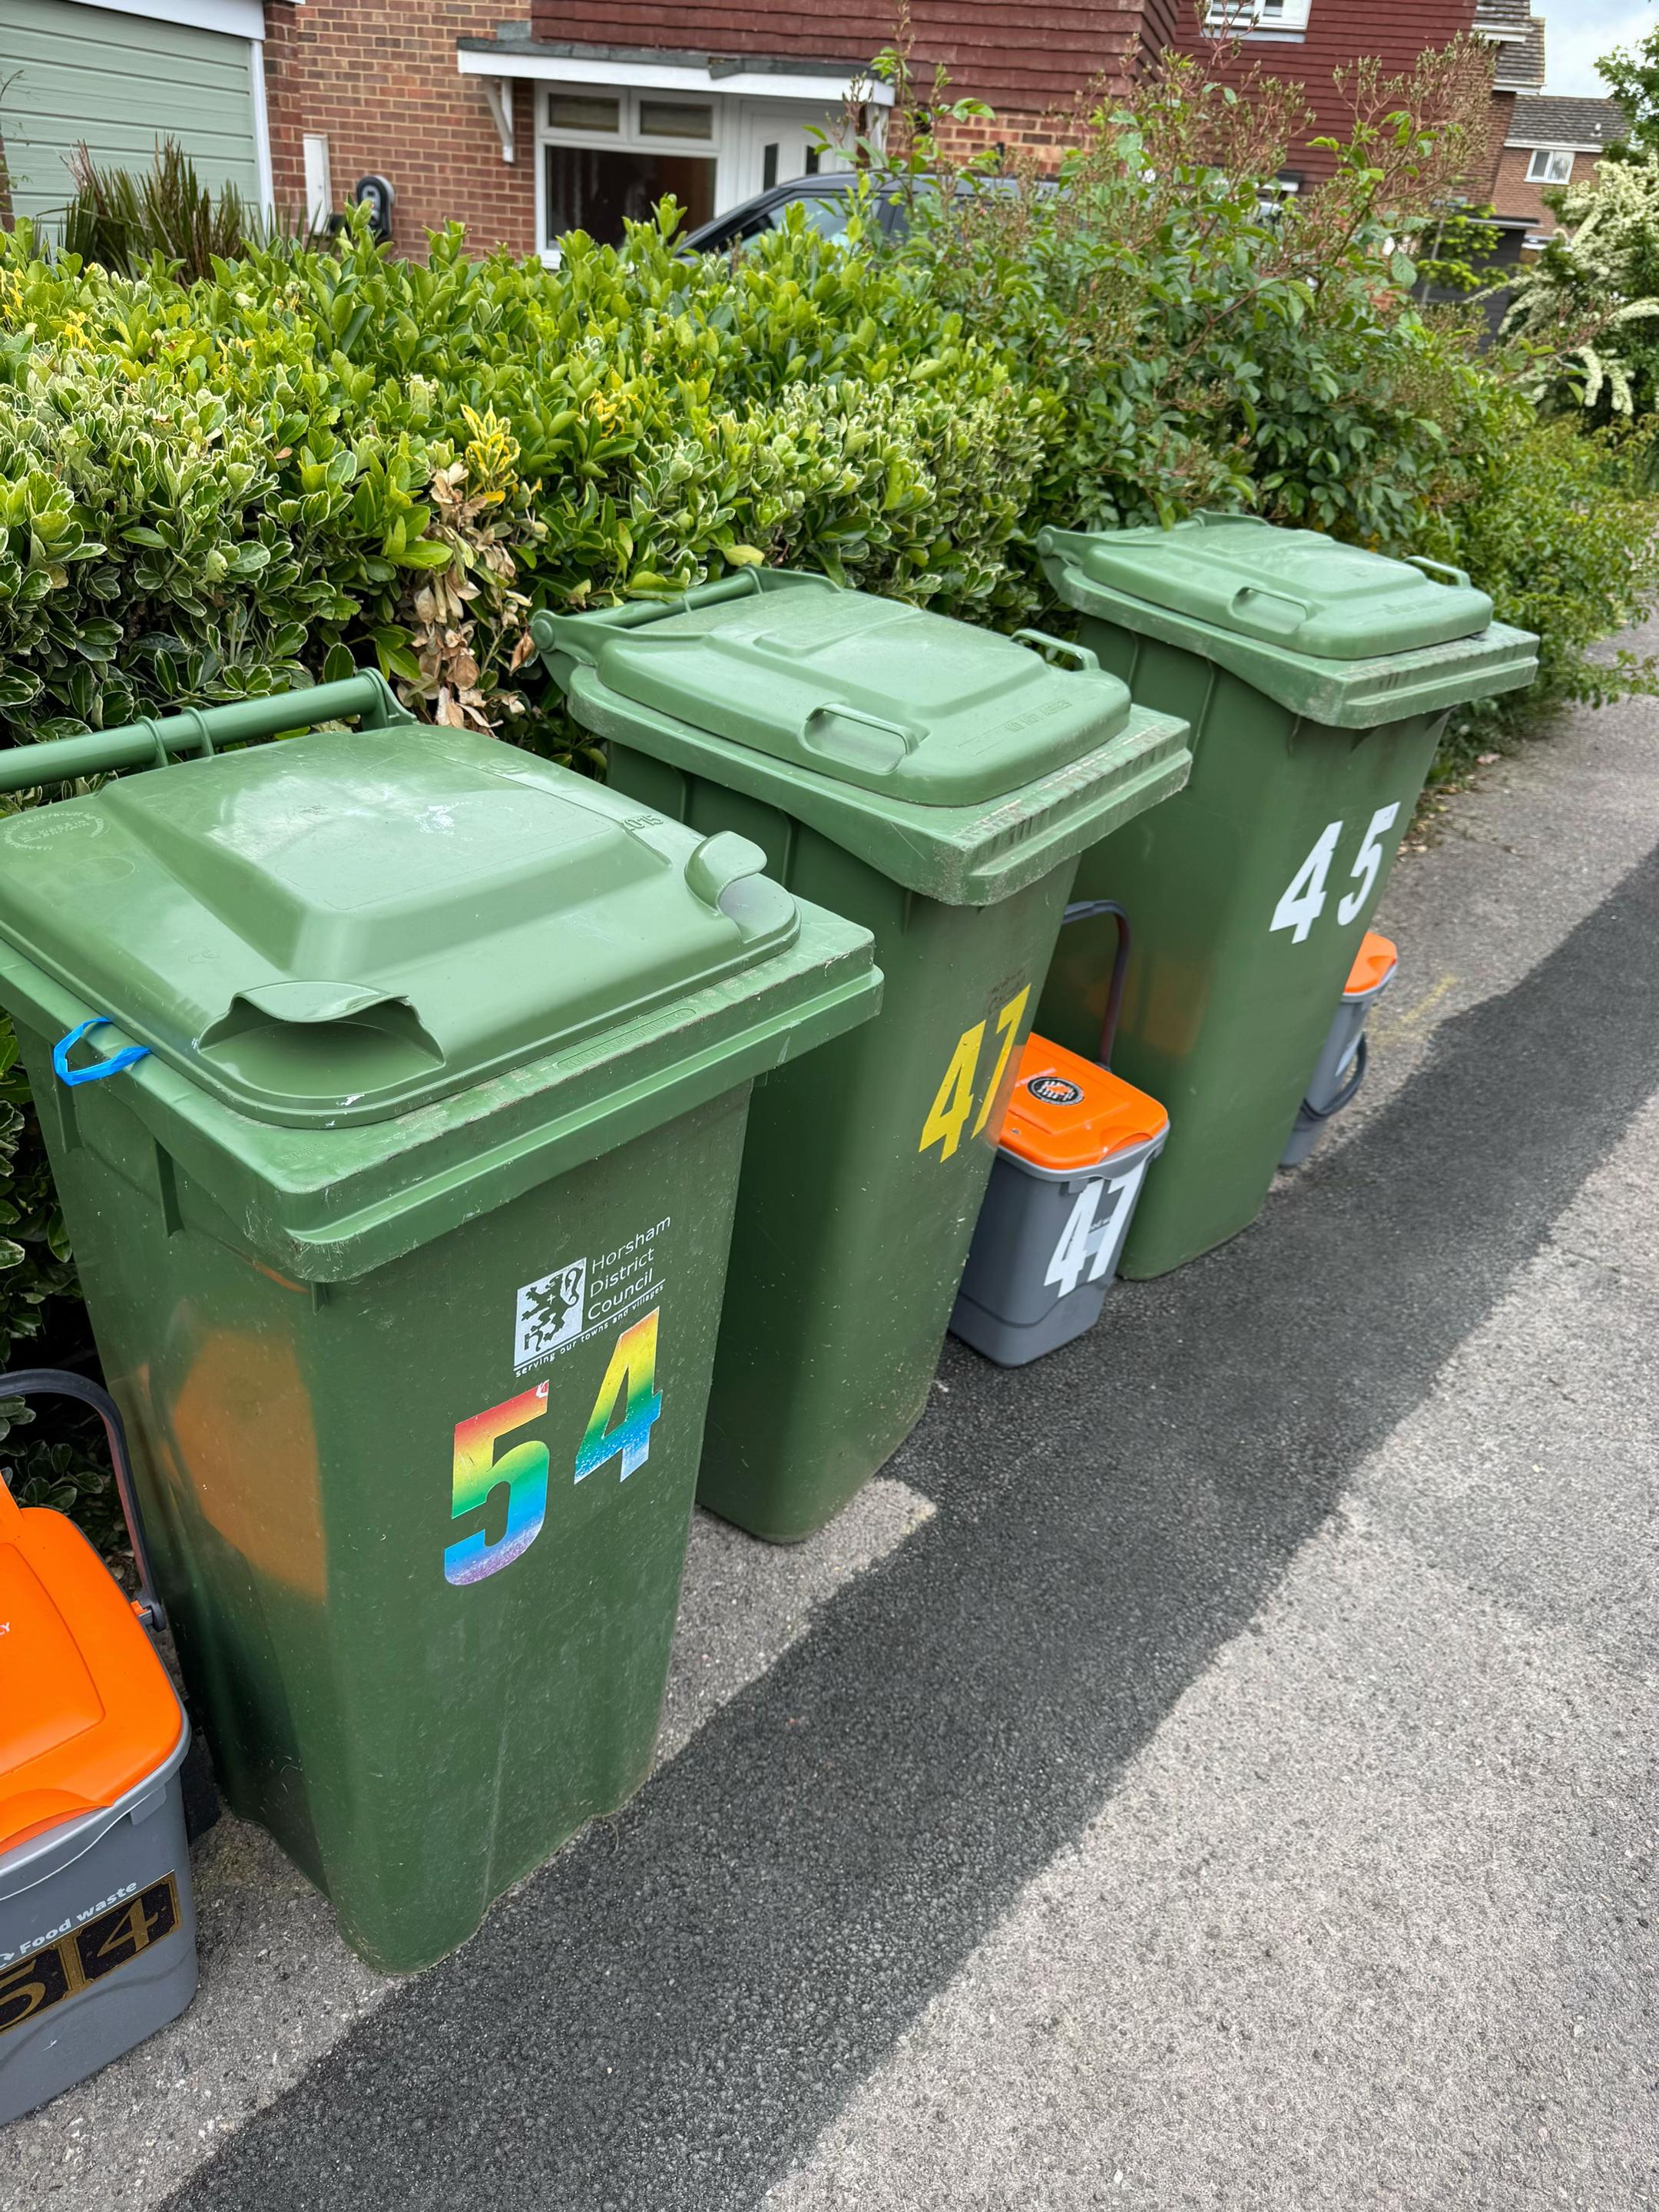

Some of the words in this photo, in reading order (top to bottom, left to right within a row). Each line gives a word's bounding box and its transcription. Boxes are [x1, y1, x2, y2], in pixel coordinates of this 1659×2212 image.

[1269, 801, 1401, 944] 45
[919, 982, 1031, 1164] 47
[590, 1248, 654, 1298] District
[591, 1216, 671, 1274] Horsham
[1043, 1161, 1146, 1298] 47
[515, 1353, 556, 1378] serving
[560, 1340, 577, 1355] our
[581, 1323, 609, 1343] towns
[612, 1307, 628, 1324] and
[632, 1283, 664, 1311] villages
[588, 1268, 653, 1320] Council
[444, 1306, 664, 1585] 54
[19, 1919, 72, 1955] Food
[76, 1882, 137, 1922] waste
